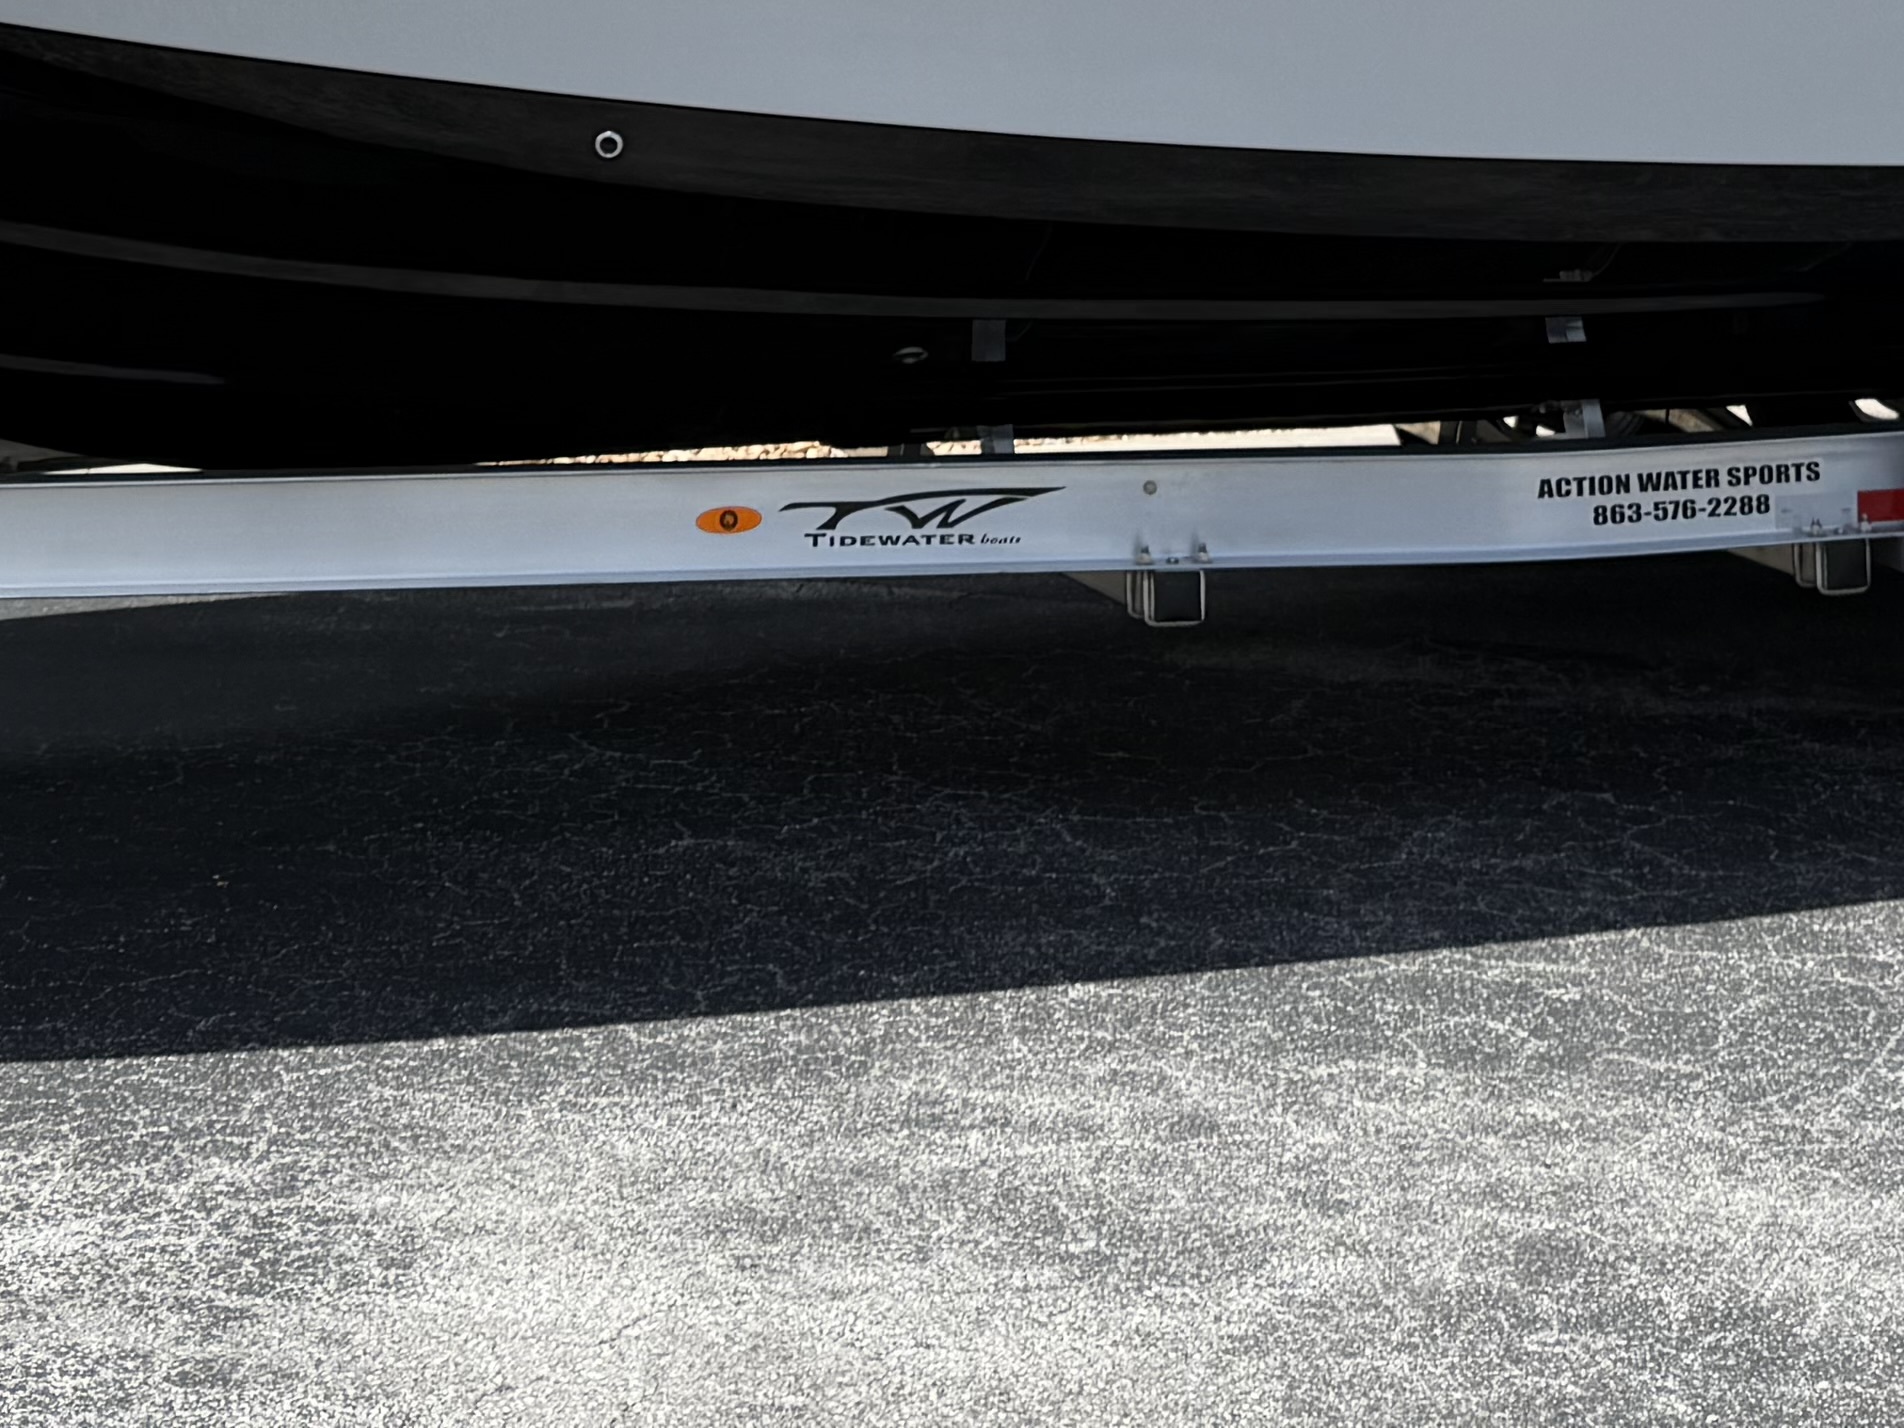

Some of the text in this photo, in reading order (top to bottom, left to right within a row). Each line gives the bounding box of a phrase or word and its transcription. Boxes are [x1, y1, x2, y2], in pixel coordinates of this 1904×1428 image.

[1537, 460, 1821, 499] ACTION WATER SPORTS
[1592, 493, 1771, 526] 863-576-2288
[804, 532, 976, 548] TIDEWATER
